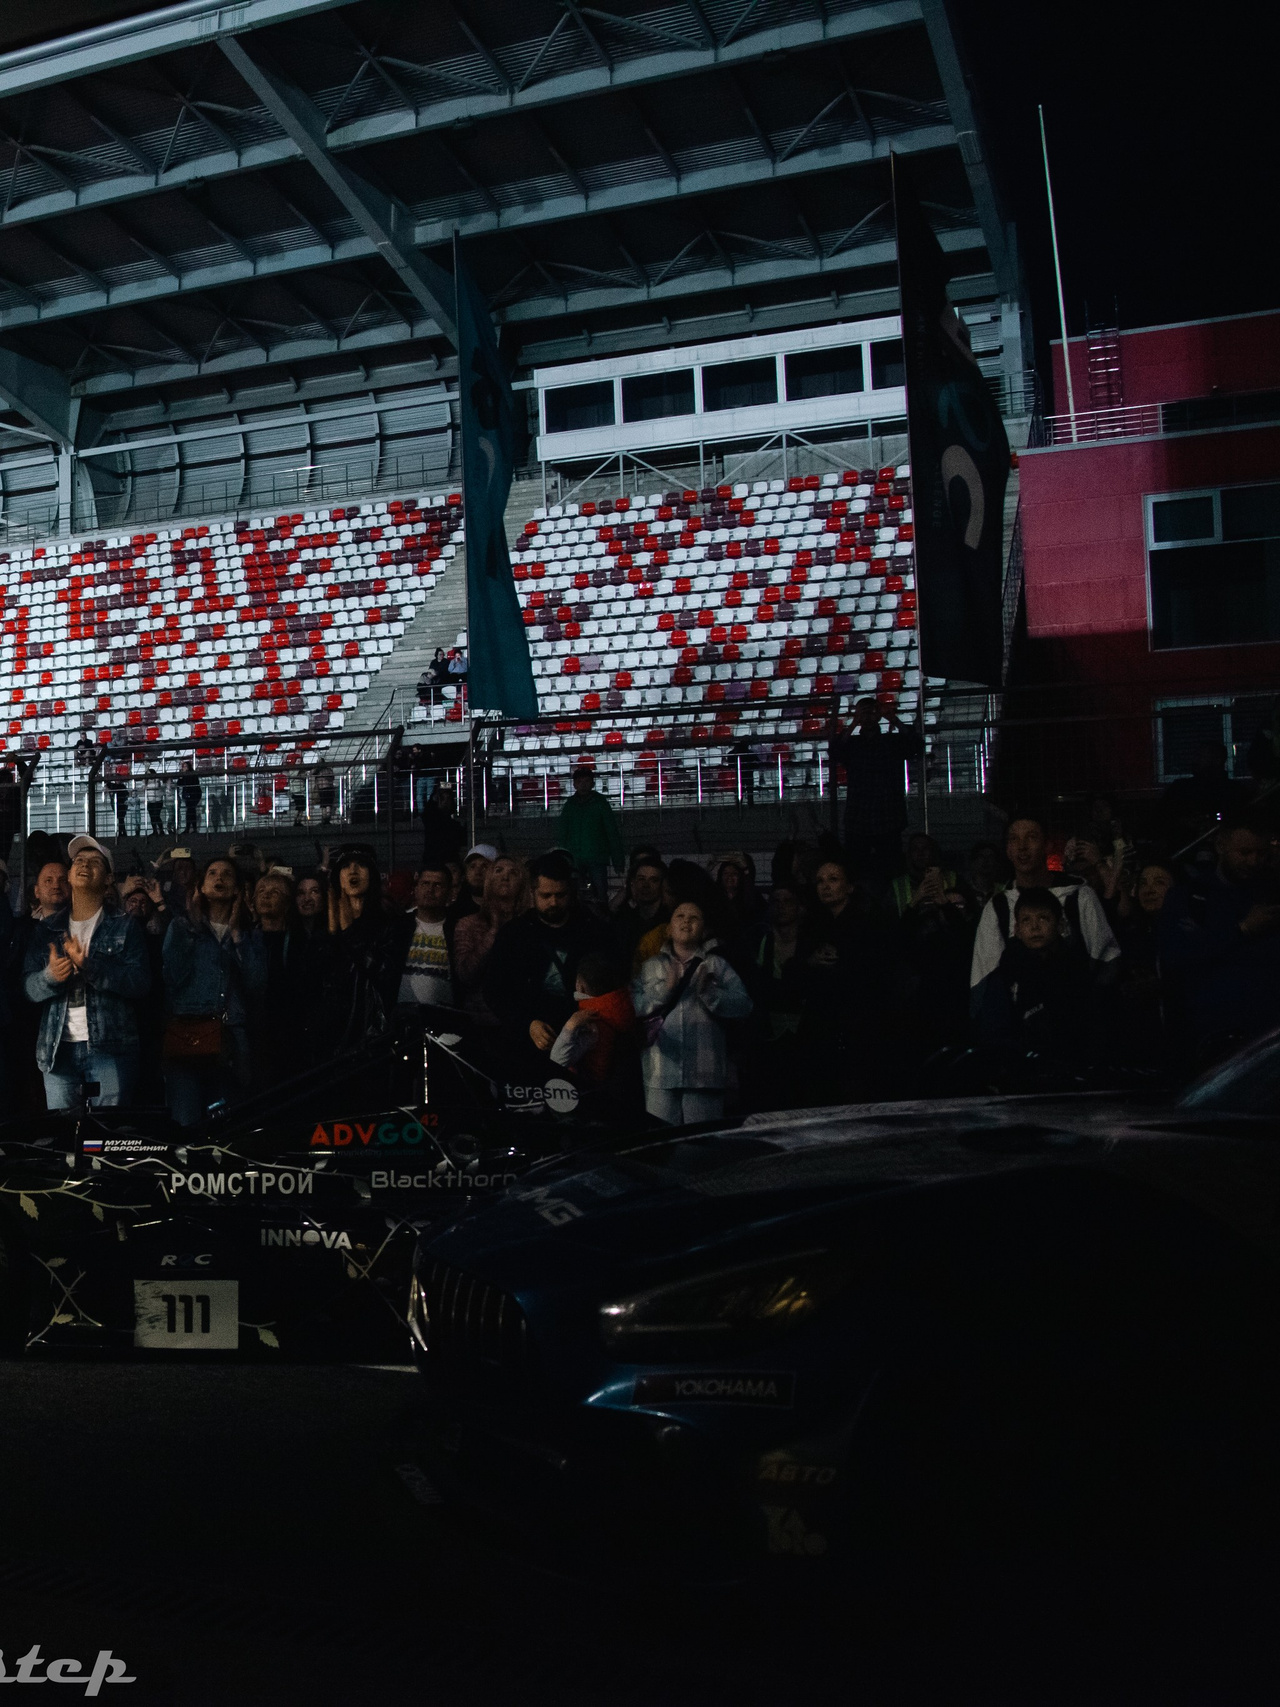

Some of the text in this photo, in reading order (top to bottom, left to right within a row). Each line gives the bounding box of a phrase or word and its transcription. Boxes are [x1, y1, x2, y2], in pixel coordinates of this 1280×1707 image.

[504, 1083, 579, 1100] terasms
[310, 1121, 424, 1146] ADVGO
[372, 1170, 518, 1189] Blackthorn
[260, 1228, 353, 1250] INNOVA
[161, 1294, 211, 1334] 111
[675, 1379, 778, 1397] YOKOHAMA
